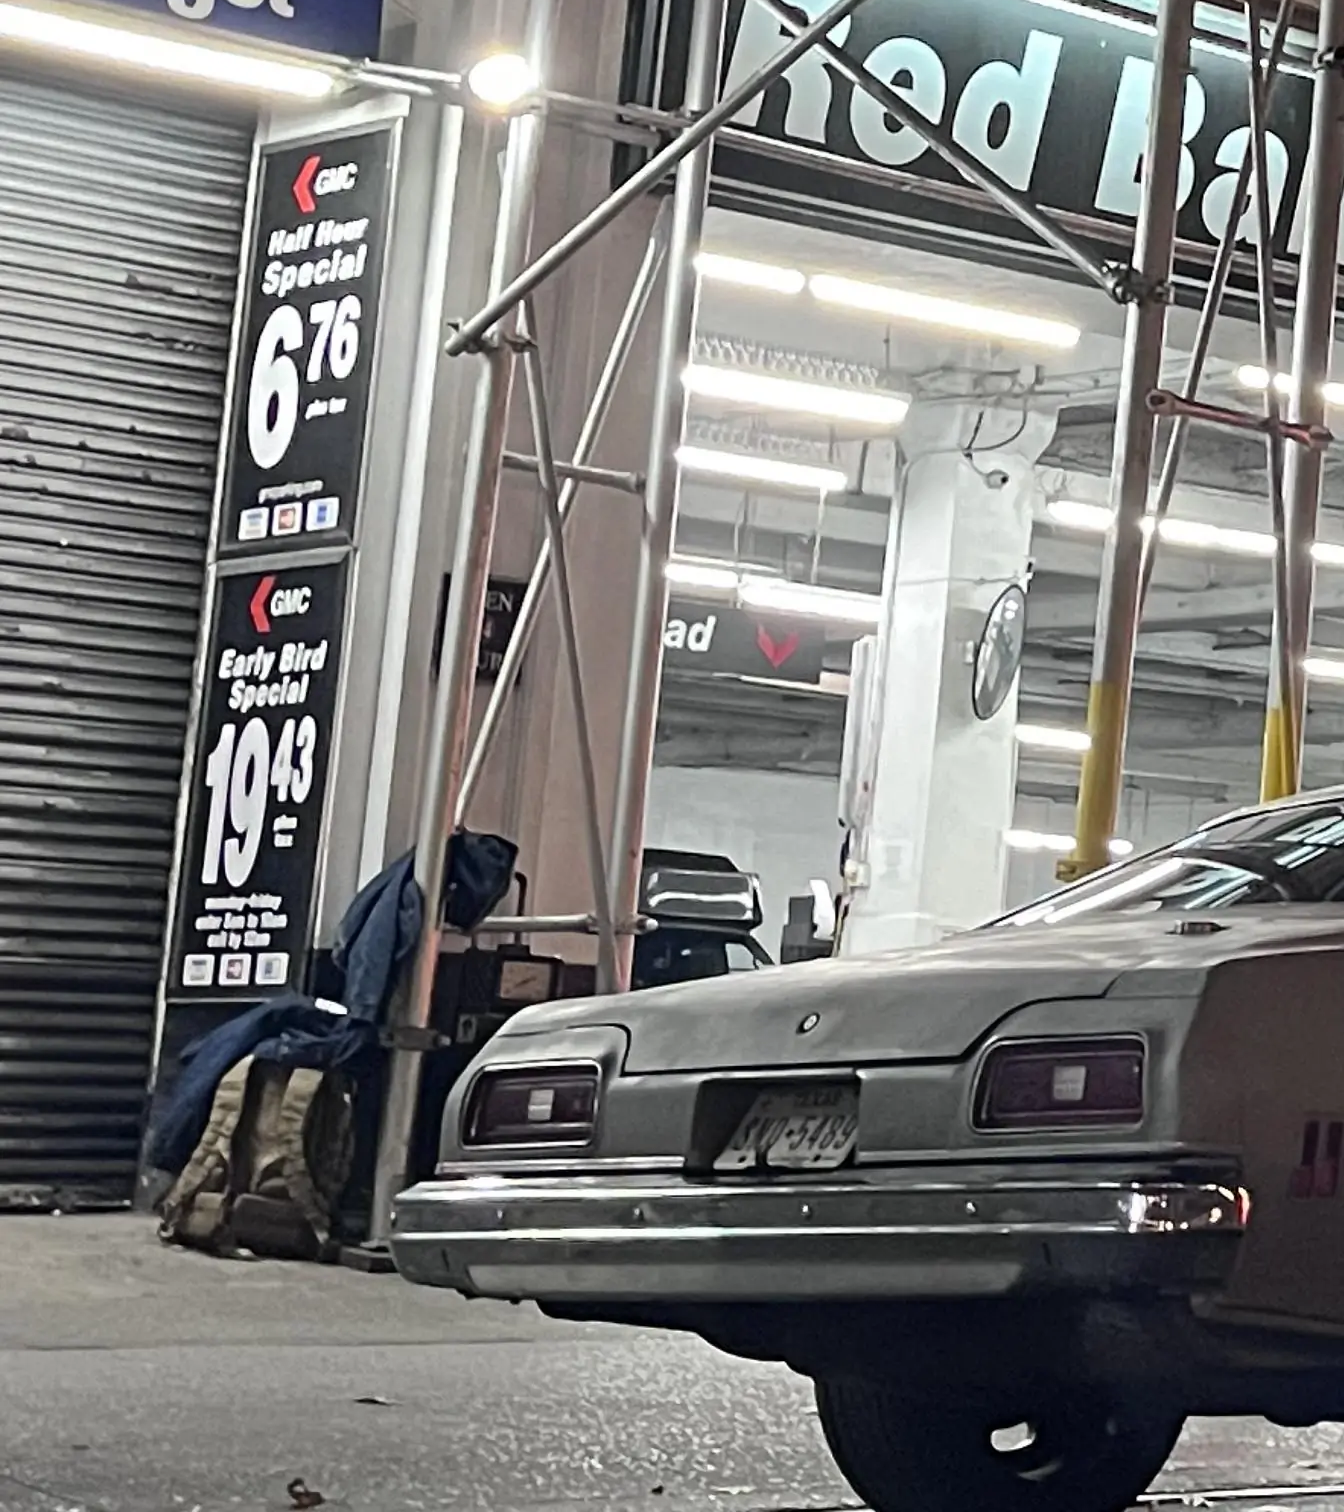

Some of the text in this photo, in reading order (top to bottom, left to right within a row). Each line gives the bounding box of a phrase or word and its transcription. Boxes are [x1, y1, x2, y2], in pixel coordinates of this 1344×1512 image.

[268, 218, 370, 257] Half Hour
[261, 243, 368, 298] Special
[270, 587, 312, 617] GMC
[218, 640, 328, 682] Early Bird
[228, 674, 310, 713] Special
